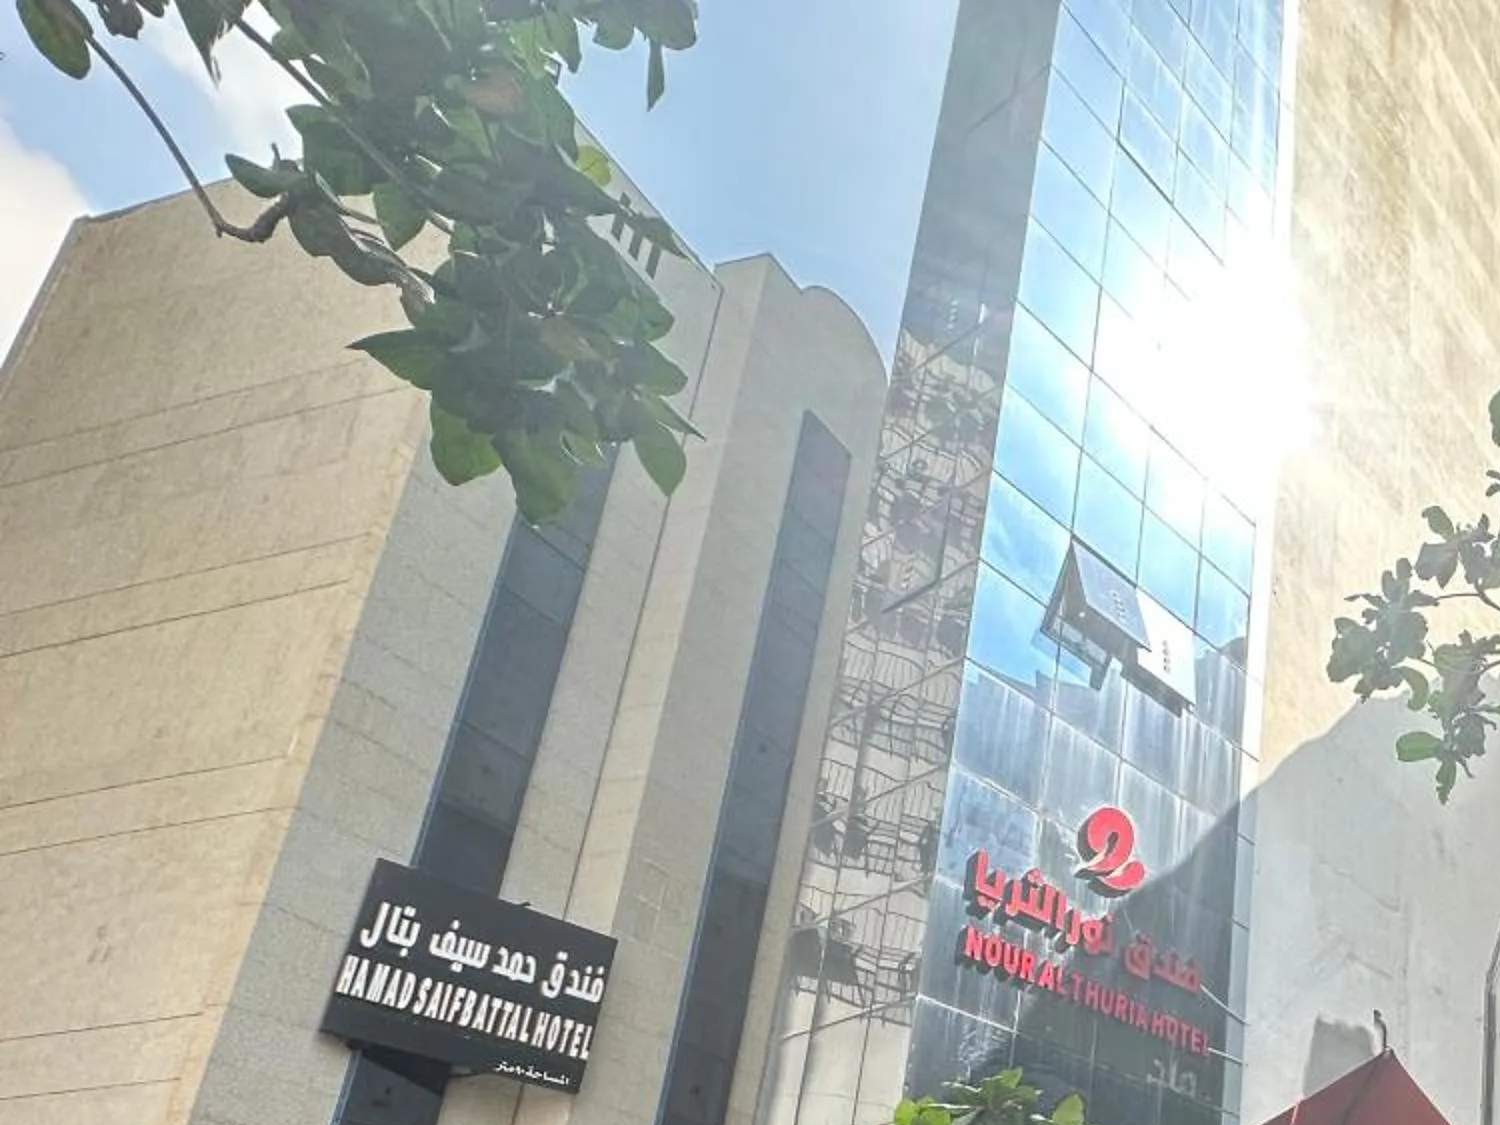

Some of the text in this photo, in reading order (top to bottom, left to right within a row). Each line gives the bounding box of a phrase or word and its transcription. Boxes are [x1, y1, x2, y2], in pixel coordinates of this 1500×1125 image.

[360, 902, 605, 1003] فندق حمد سيف بتال
[975, 848, 1202, 993] فندق نور الثريا
[335, 955, 594, 1060] HAMAD SAIF BATTAL HOTEL
[963, 925, 1210, 1059] NOUR AL THURIA HOTEL
